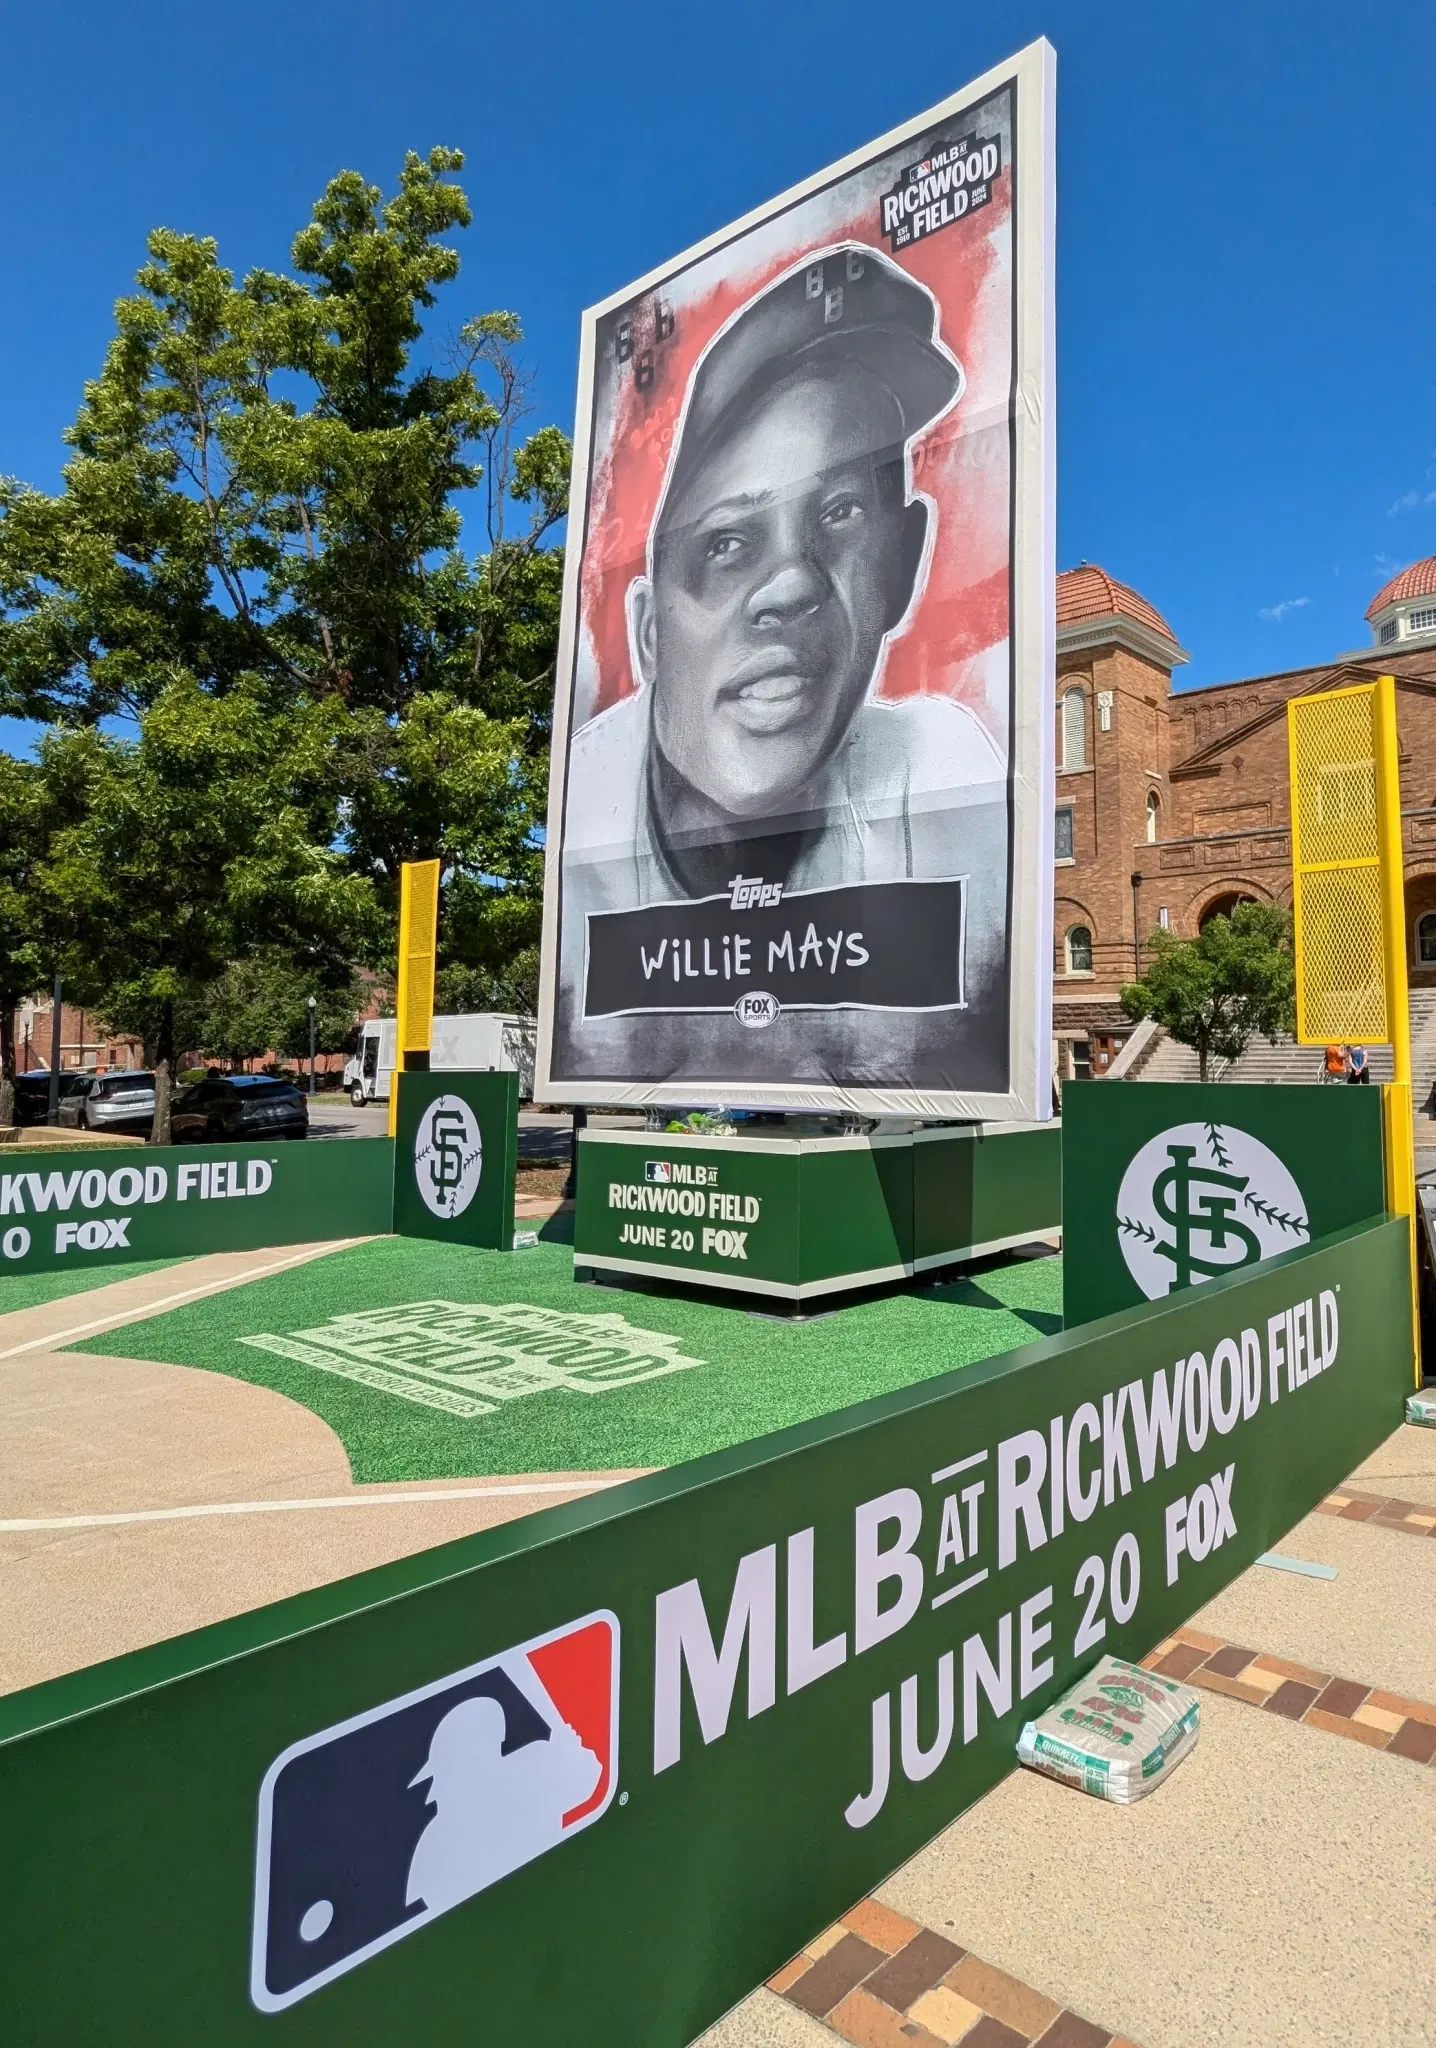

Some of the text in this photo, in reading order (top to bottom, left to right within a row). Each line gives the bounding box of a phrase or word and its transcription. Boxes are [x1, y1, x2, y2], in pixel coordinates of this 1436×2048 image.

[932, 143, 968, 171] MLB AT
[884, 143, 998, 232] RICKWOOD
[971, 184, 987, 198] JUNE
[971, 192, 987, 207] 2024
[897, 225, 909, 237] EST
[913, 189, 969, 239] FIELD
[896, 232, 911, 245] 1910
[768, 922, 870, 975] MAYS
[744, 999, 770, 1014] FOX
[672, 1164, 718, 1185] MLB AT
[609, 1183, 705, 1217] RICKWOOD
[55, 1217, 132, 1254] FOX
[619, 1224, 748, 1259] JUNE 20 FOX
[347, 1331, 516, 1375] FIELD
[354, 1304, 670, 1382] RICKWOOD
[353, 1368, 413, 1391] NEGRO
[401, 1383, 480, 1414] LEAGUES
[653, 1487, 924, 1776] MLB
[936, 1480, 985, 1575] AT
[999, 1328, 1263, 1570] RICKWOOD
[844, 1462, 1237, 1829] JUNE 20 FOX
[1042, 1740, 1079, 1762] QUIKRETE
